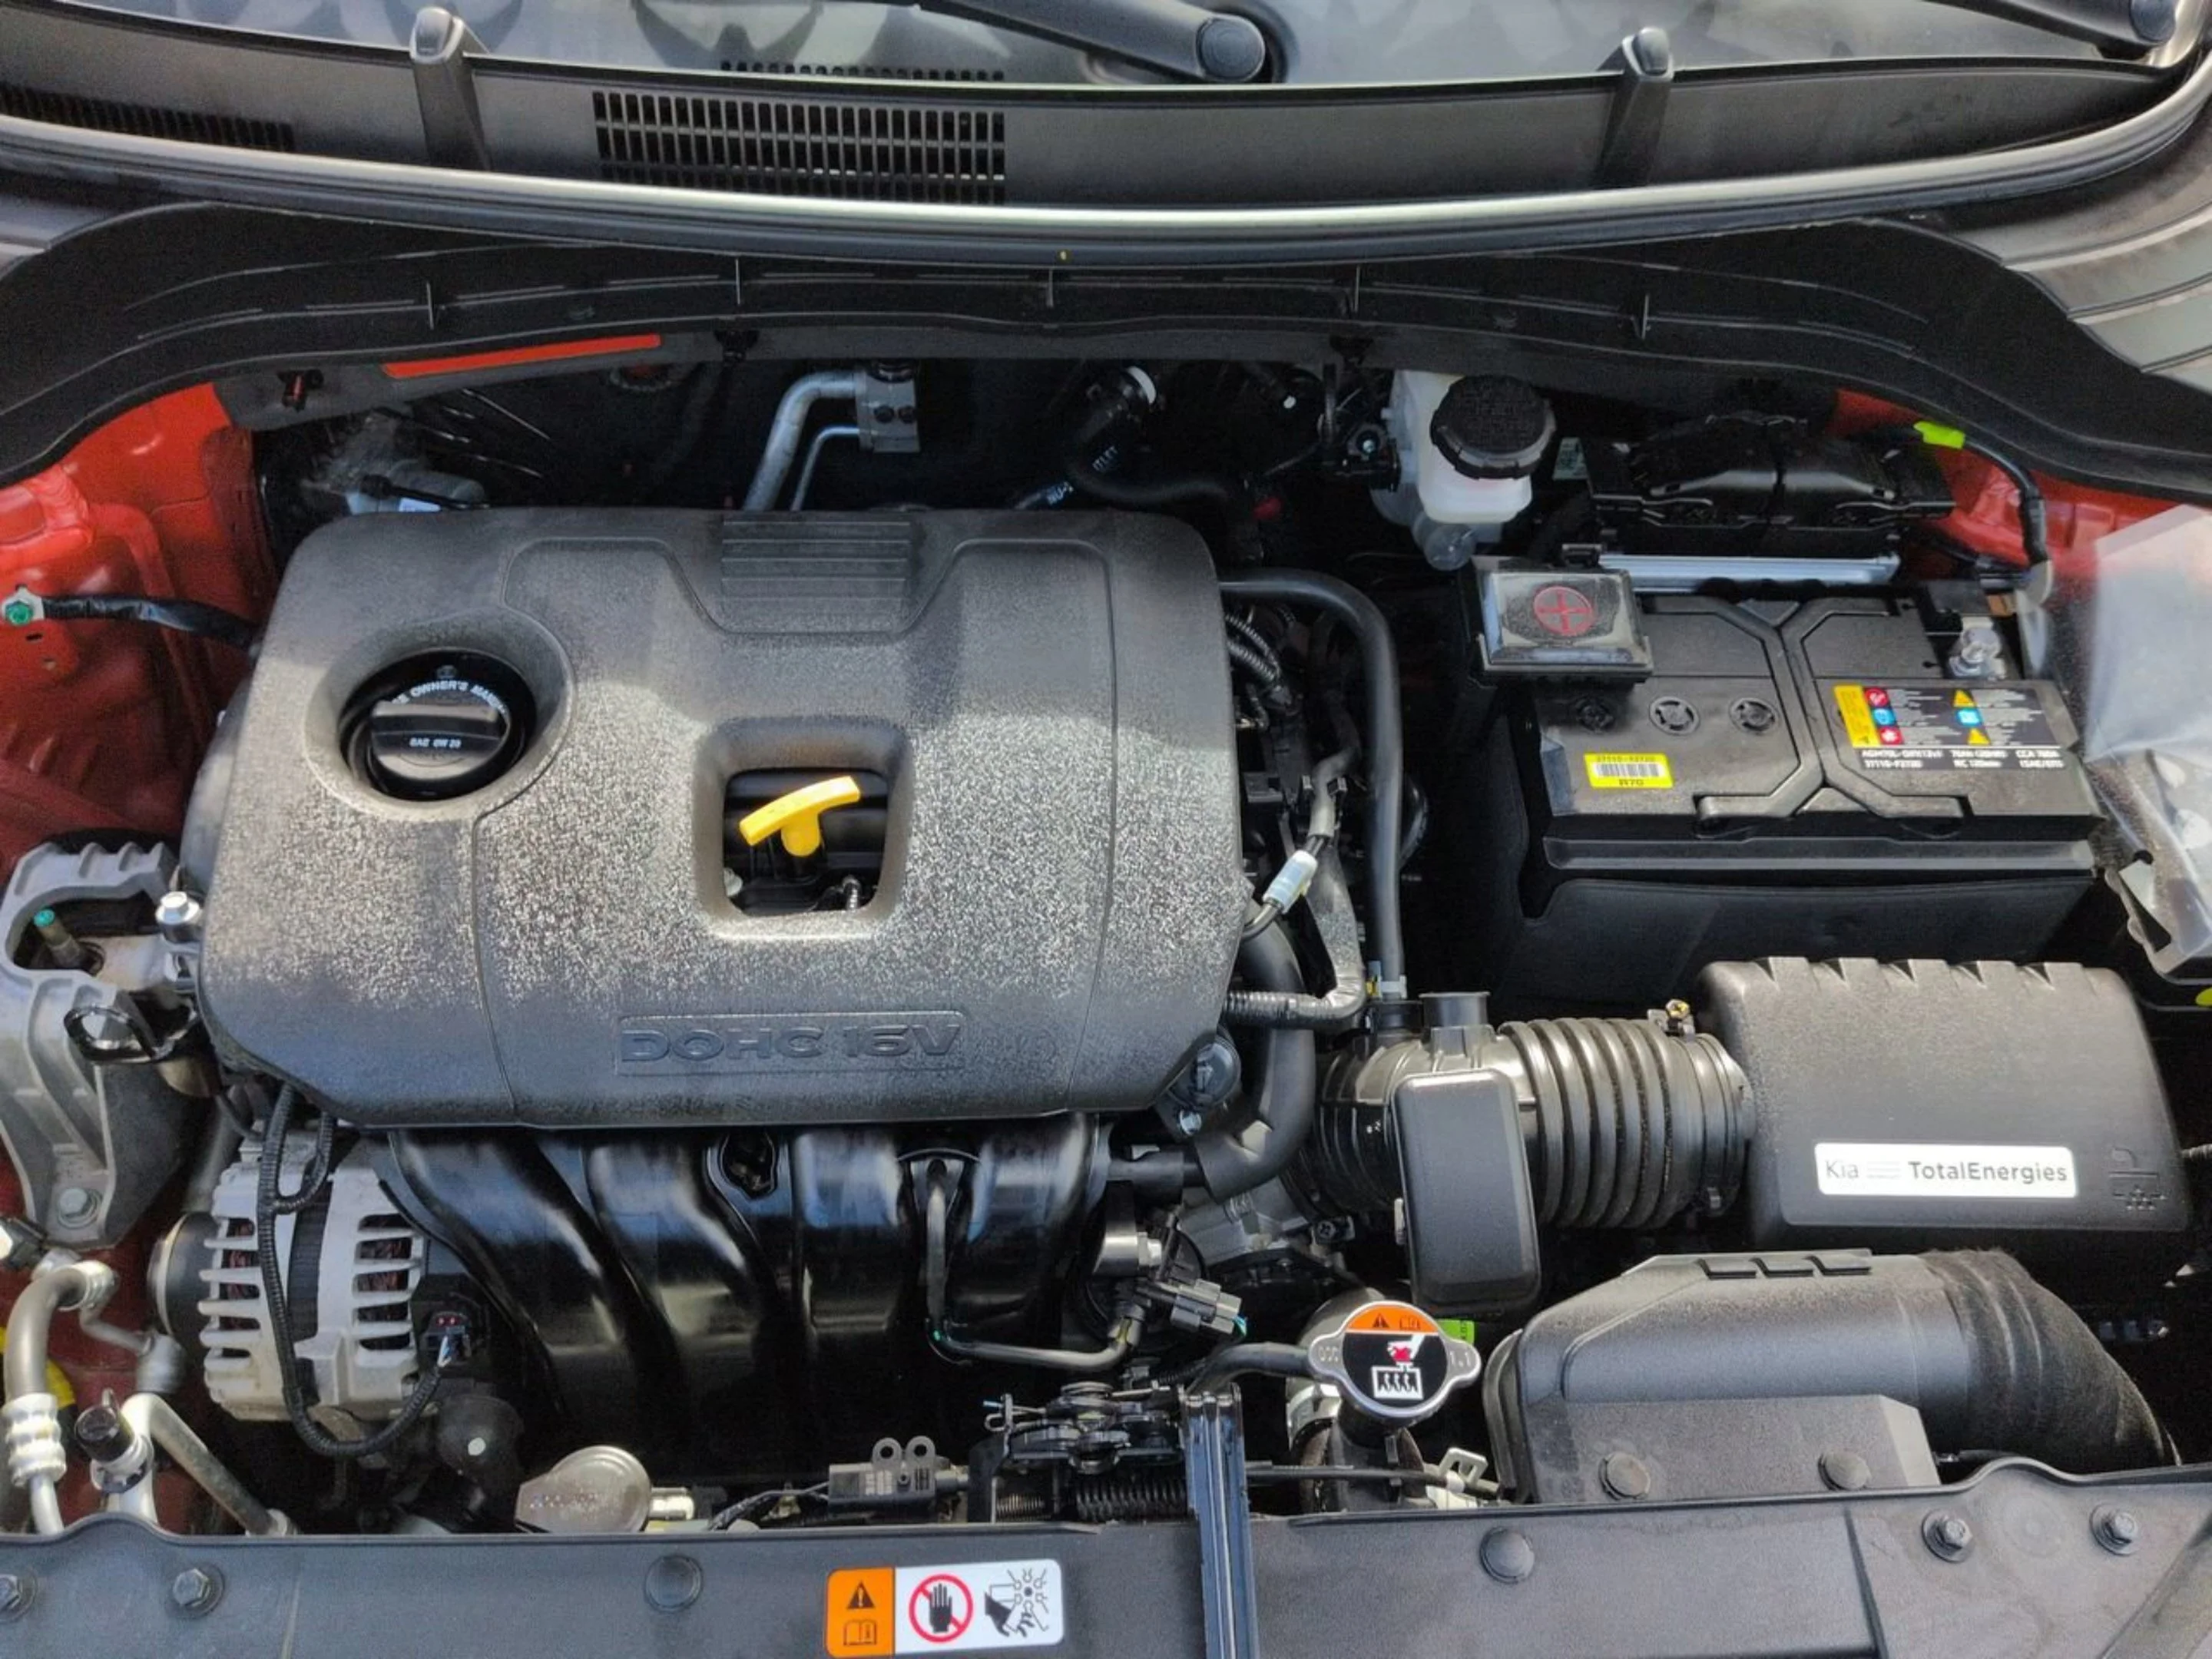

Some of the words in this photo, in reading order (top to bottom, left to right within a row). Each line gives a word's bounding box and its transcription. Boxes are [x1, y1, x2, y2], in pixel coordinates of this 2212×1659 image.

[410, 680, 469, 697] OWNER'S
[621, 1028, 824, 1063] DOHC
[842, 1023, 962, 1058] 16V
[1825, 1159, 1859, 1180] Kia
[1907, 1161, 2068, 1185] TotalEnergies
